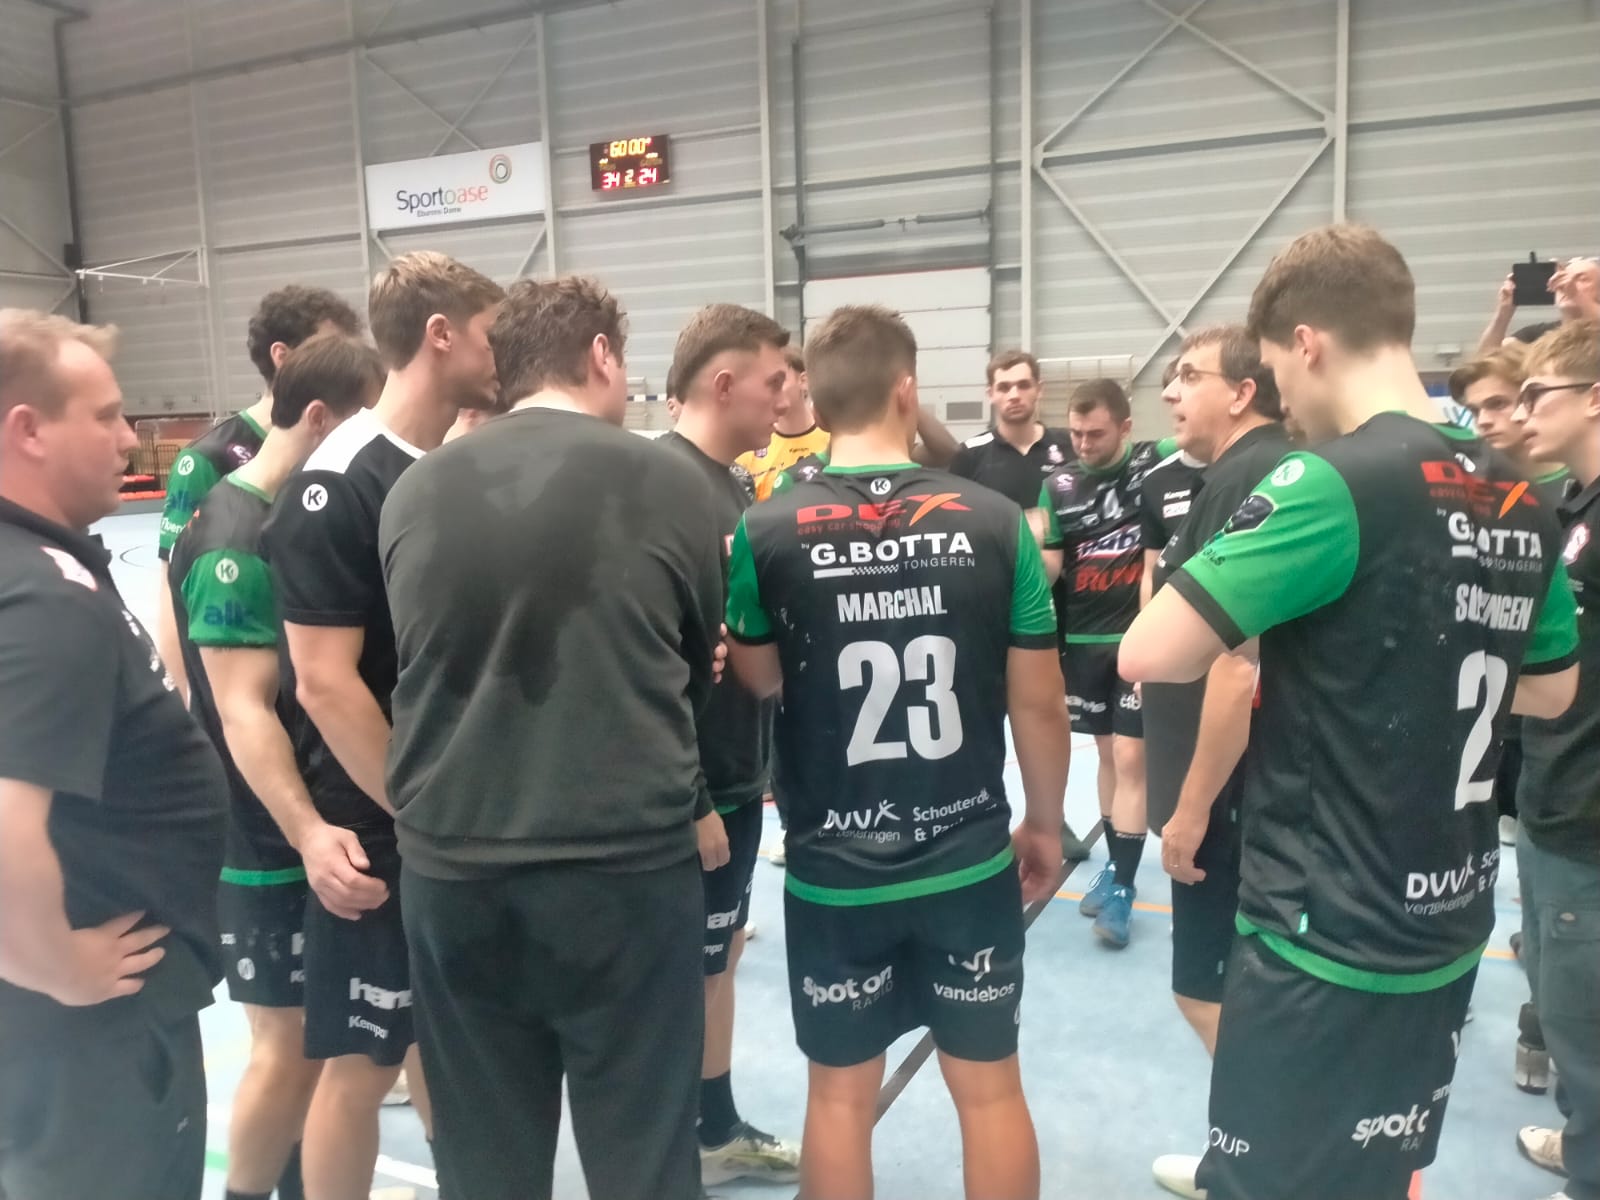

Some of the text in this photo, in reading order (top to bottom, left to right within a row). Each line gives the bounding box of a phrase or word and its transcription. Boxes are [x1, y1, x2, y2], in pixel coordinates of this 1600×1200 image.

[602, 171, 621, 189] 34
[638, 167, 658, 185] 24
[396, 185, 489, 214] Sportoase
[810, 532, 974, 566] G.BOTTA
[903, 557, 976, 571] TONGEREN
[836, 585, 948, 623] MARCHAL
[836, 634, 964, 767] 23
[1453, 649, 1509, 812] 2
[802, 965, 893, 1007] spot on
[348, 1015, 389, 1040] Kempa
[1209, 1127, 1250, 1157] OUP
[1351, 1104, 1419, 1149] spot
